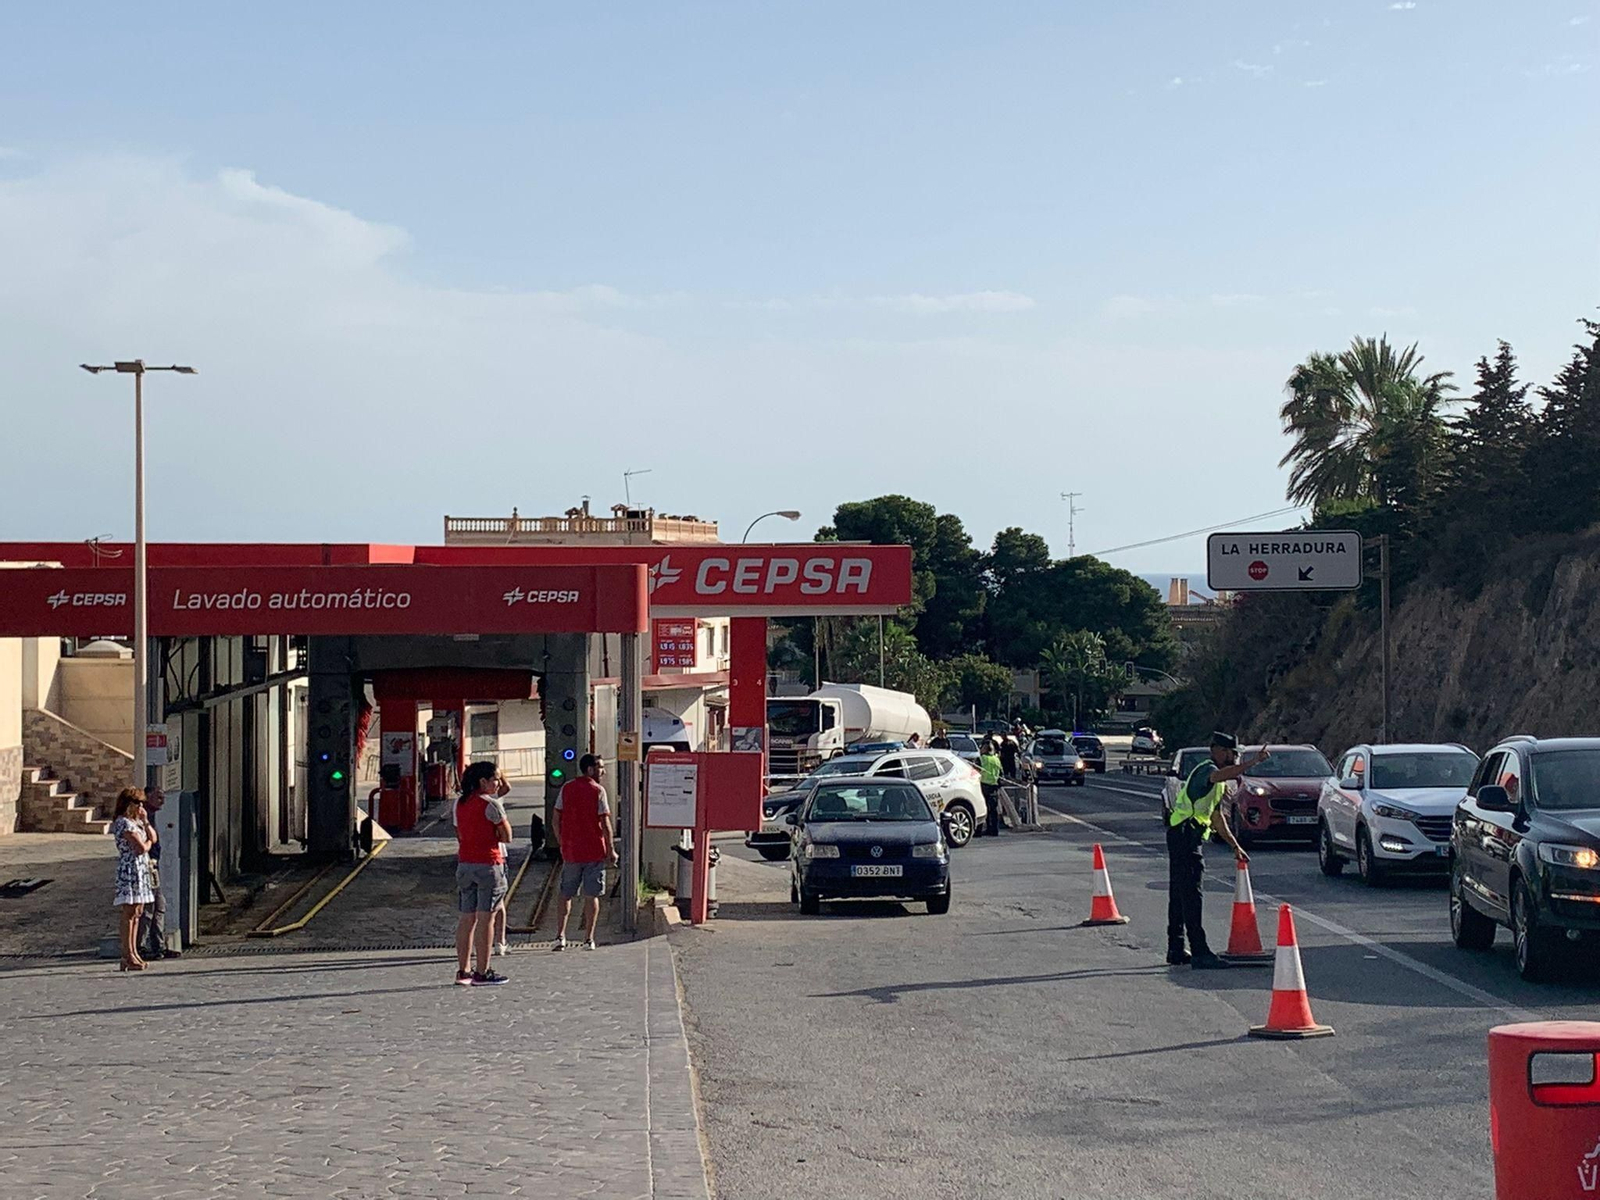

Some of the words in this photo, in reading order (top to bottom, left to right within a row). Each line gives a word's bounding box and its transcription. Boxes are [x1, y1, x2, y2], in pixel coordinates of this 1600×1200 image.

[1221, 544, 1240, 555] LA
[1249, 542, 1347, 555] HERRADURA
[695, 558, 873, 594] CEPSA
[72, 593, 126, 606] CEPSA
[173, 589, 261, 610] Lavado
[268, 588, 411, 609] automático
[527, 590, 579, 603] CEPSA
[856, 866, 881, 876] 0352
[883, 866, 901, 876] BNT
